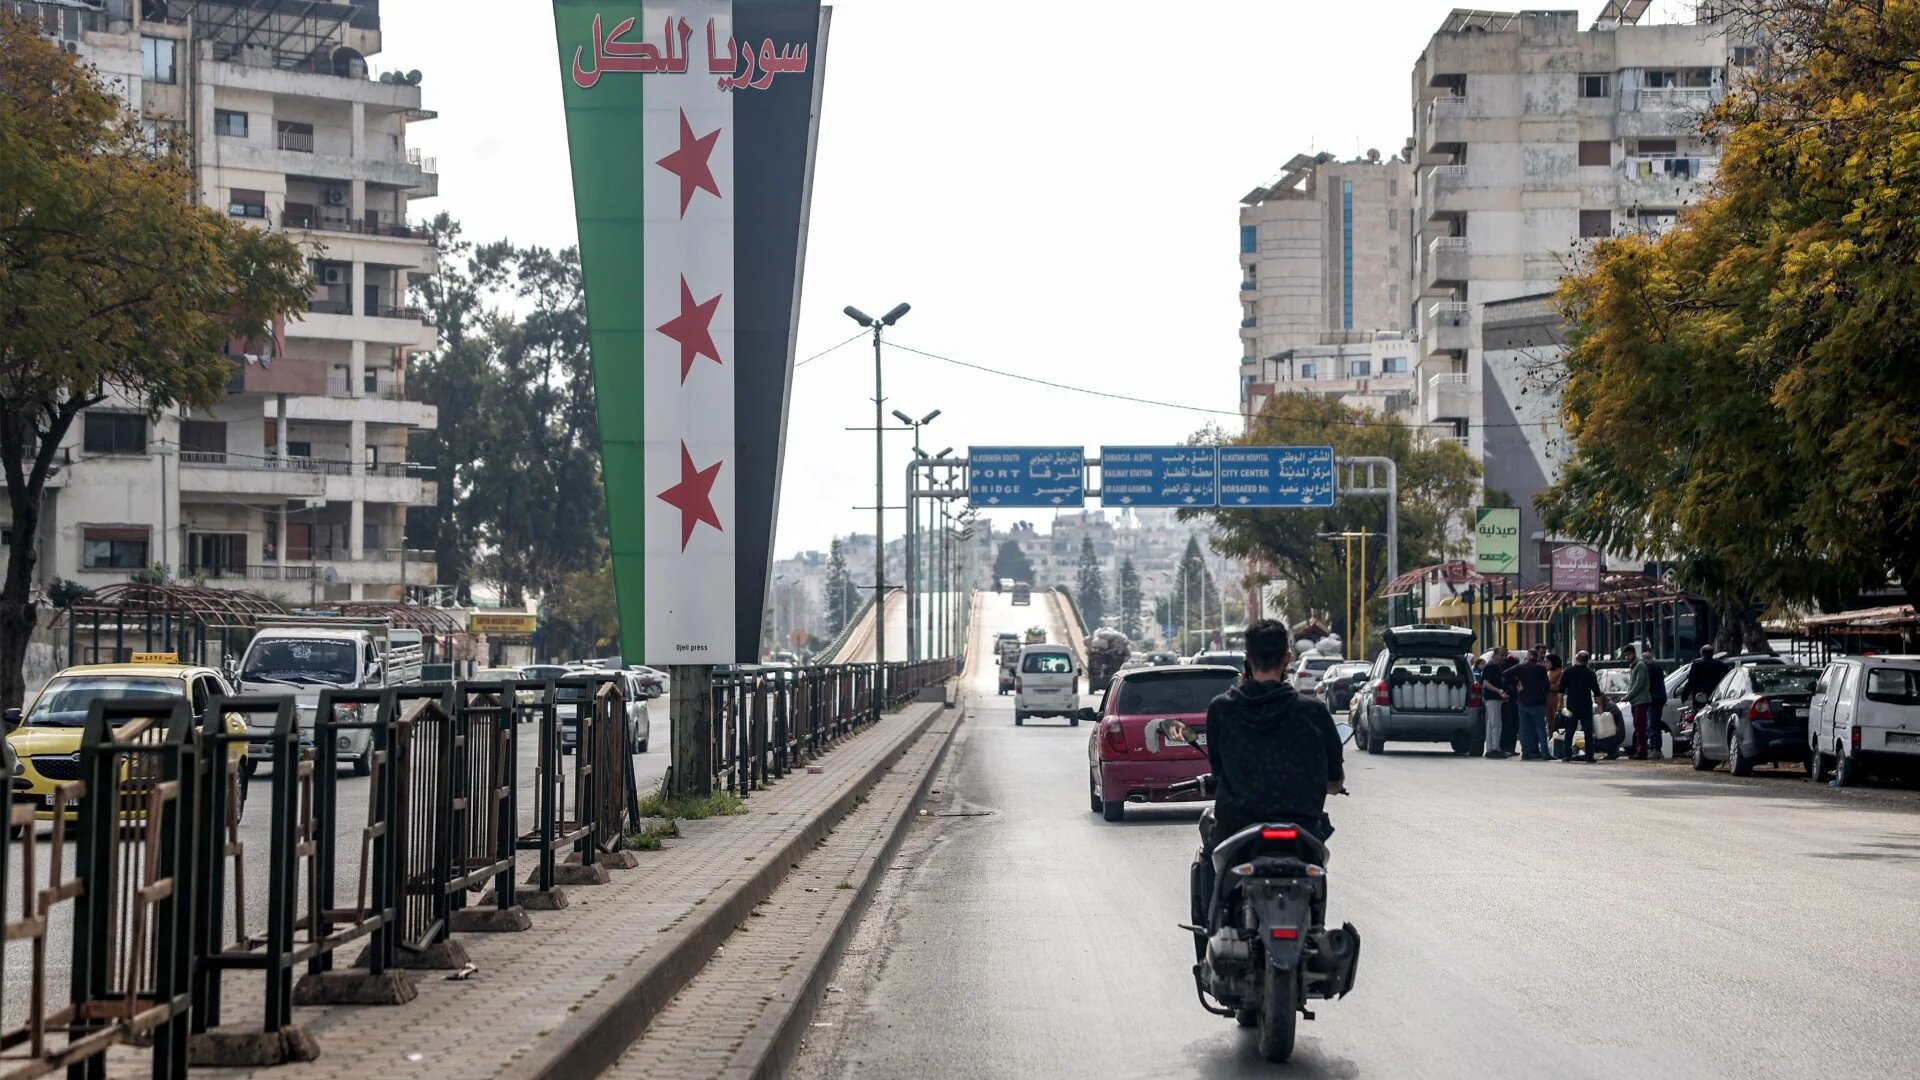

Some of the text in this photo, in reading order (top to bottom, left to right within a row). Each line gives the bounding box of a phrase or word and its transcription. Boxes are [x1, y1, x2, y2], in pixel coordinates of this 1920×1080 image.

[572, 13, 808, 90] سوريا للكل
[1162, 453, 1185, 464] حلب
[1191, 450, 1212, 464] دمشق
[1279, 452, 1305, 465] الوطني
[1163, 466, 1212, 480] محطة القطار
[1279, 466, 1330, 479] مركز المدينة
[1032, 485, 1079, 496] جسر
[1280, 481, 1330, 495] شارع بور سعيد
[1479, 523, 1516, 538] صيدلية
[1554, 555, 1598, 573] صيدلية
